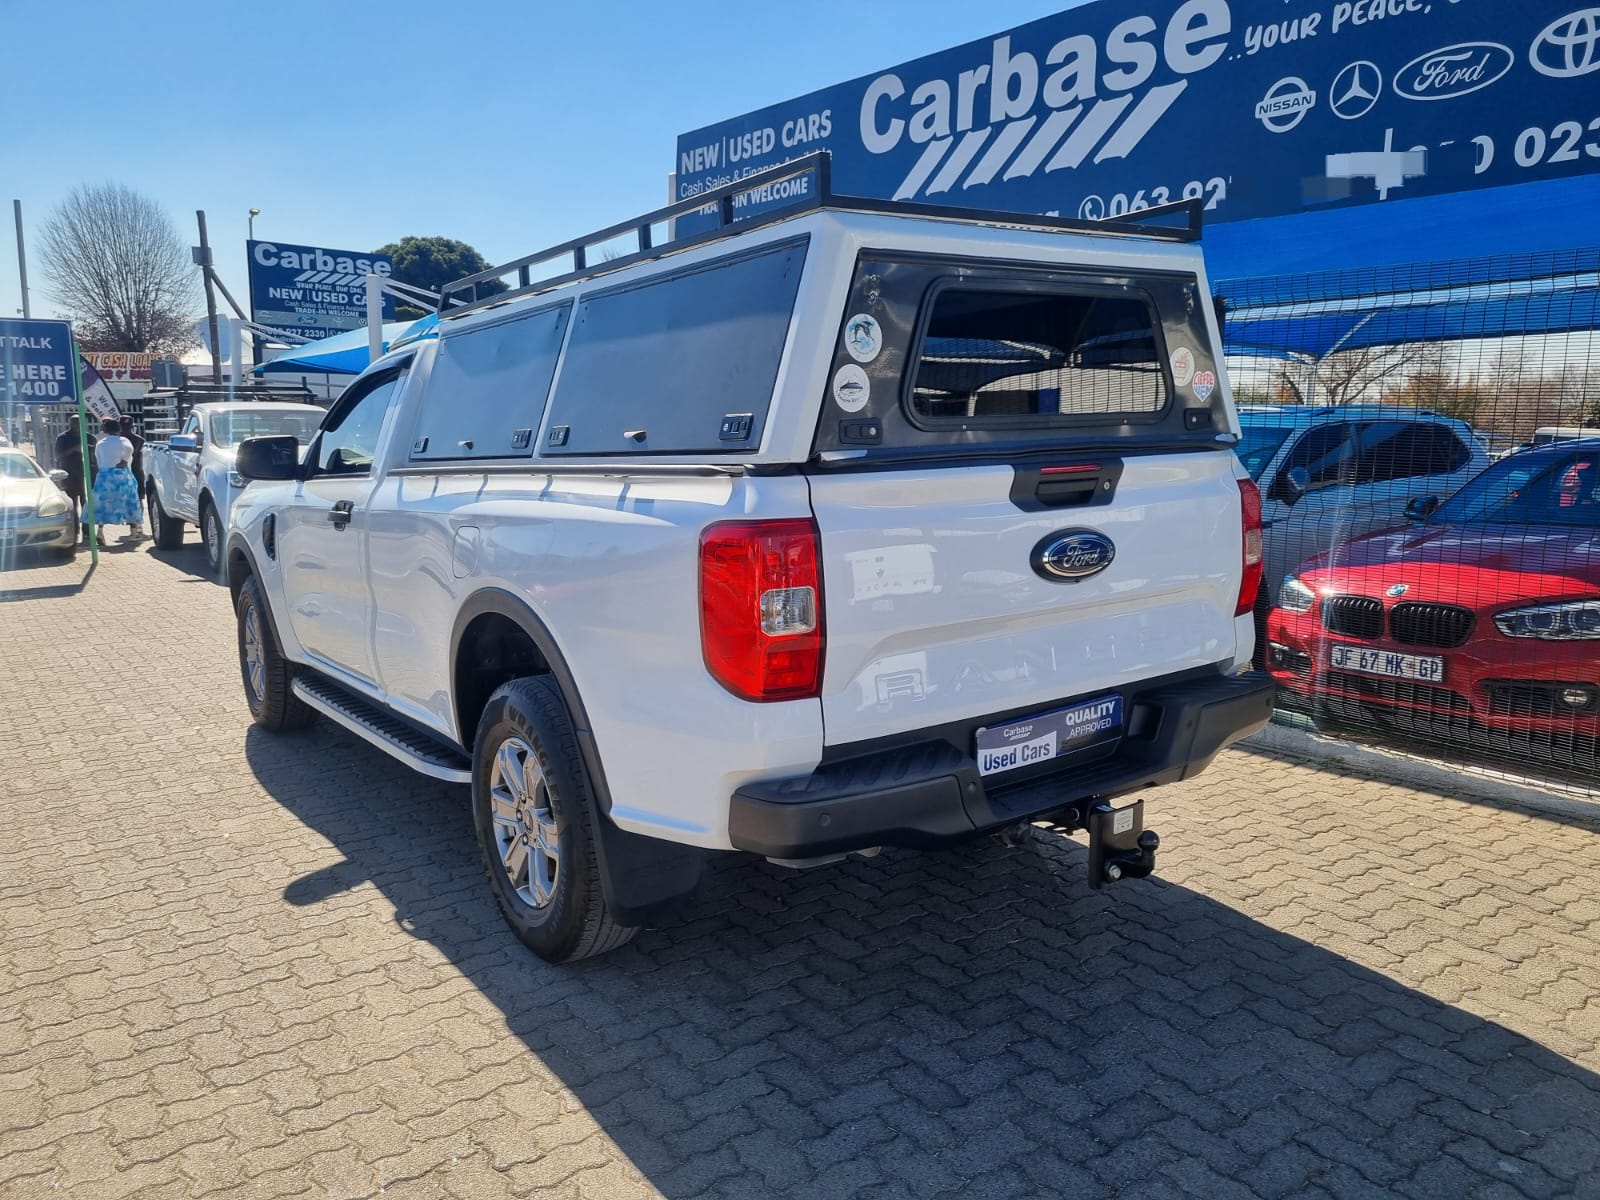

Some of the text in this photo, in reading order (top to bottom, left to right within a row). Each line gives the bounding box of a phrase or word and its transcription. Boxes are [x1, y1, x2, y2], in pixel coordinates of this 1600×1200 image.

[859, 0, 1232, 154] Carbase
[1413, 50, 1491, 93] Ford
[1258, 94, 1313, 115] NISSAN
[681, 143, 720, 176] NEW
[729, 127, 776, 163] USED
[782, 109, 832, 148] CARS
[680, 180, 704, 199] Cash
[705, 176, 731, 191] Sales
[752, 178, 808, 204] WELCOME
[254, 243, 392, 278] Carbase
[268, 287, 386, 307] NEW USED CAS
[284, 299, 300, 307] Cash
[295, 306, 360, 318] TRADE-IN WELCOME
[8, 336, 53, 350] TALK
[304, 329, 325, 338] 2330
[100, 353, 128, 368] CASH
[12, 364, 67, 380] HERE
[98, 394, 110, 409] We
[1062, 543, 1100, 568] Ford
[872, 604, 1228, 708] RANG
[1335, 648, 1353, 667] JF
[1360, 651, 1379, 671] 67
[1419, 659, 1439, 679] GP
[1065, 701, 1115, 726] QUALITY
[1003, 724, 1034, 738] Carbase
[1069, 718, 1112, 738] APPROVED
[983, 743, 1051, 772] Used Cars
